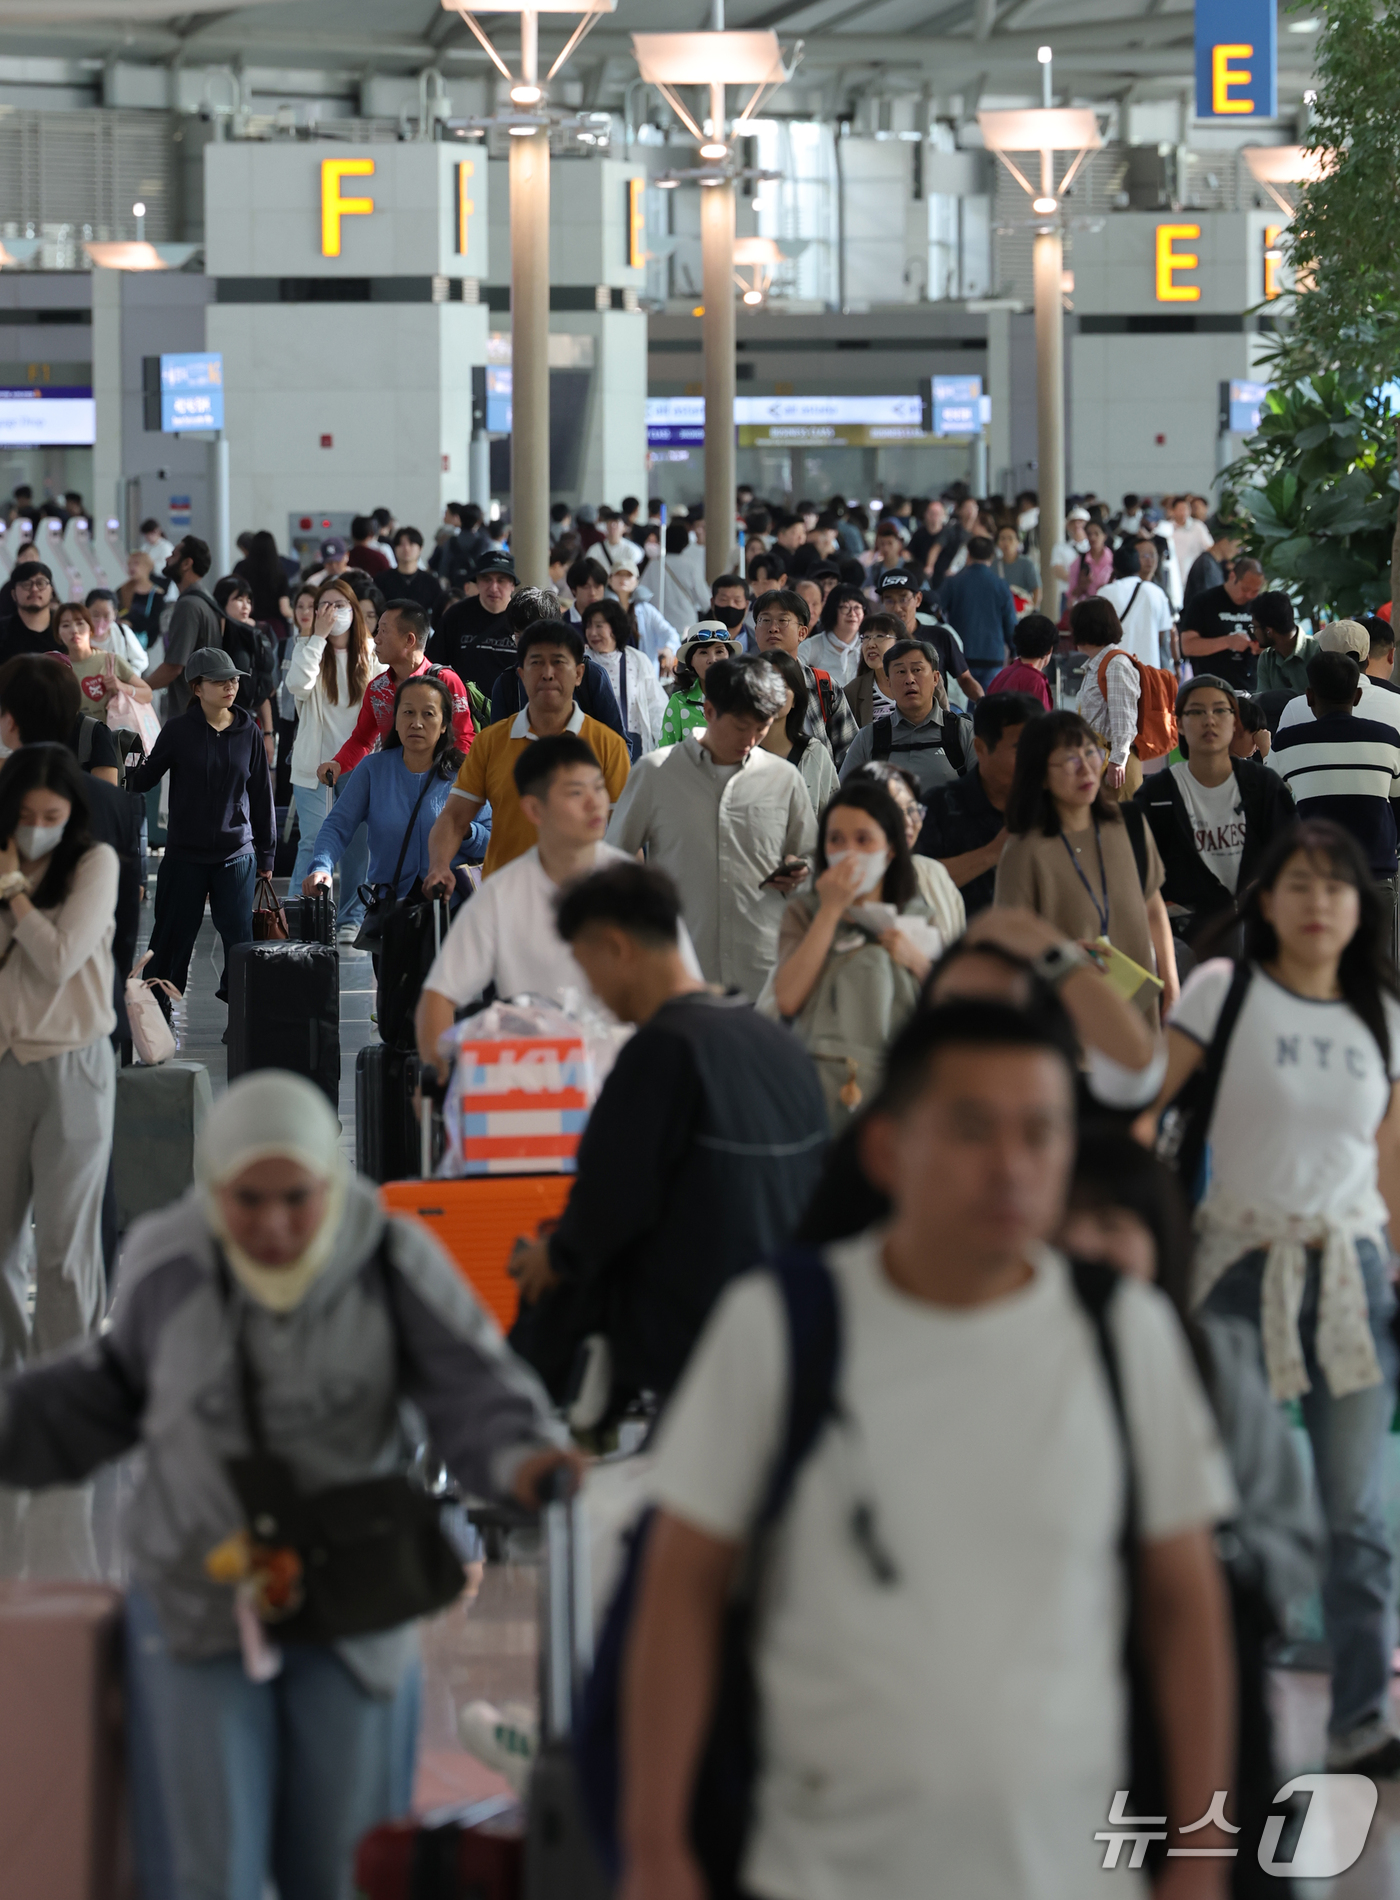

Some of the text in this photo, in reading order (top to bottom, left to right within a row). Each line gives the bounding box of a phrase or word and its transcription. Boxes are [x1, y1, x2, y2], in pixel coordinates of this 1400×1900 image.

[1212, 44, 1254, 114] E
[321, 159, 375, 257] F
[459, 160, 474, 257] F
[1155, 224, 1201, 302] E
[1276, 1034, 1368, 1080] NYC
